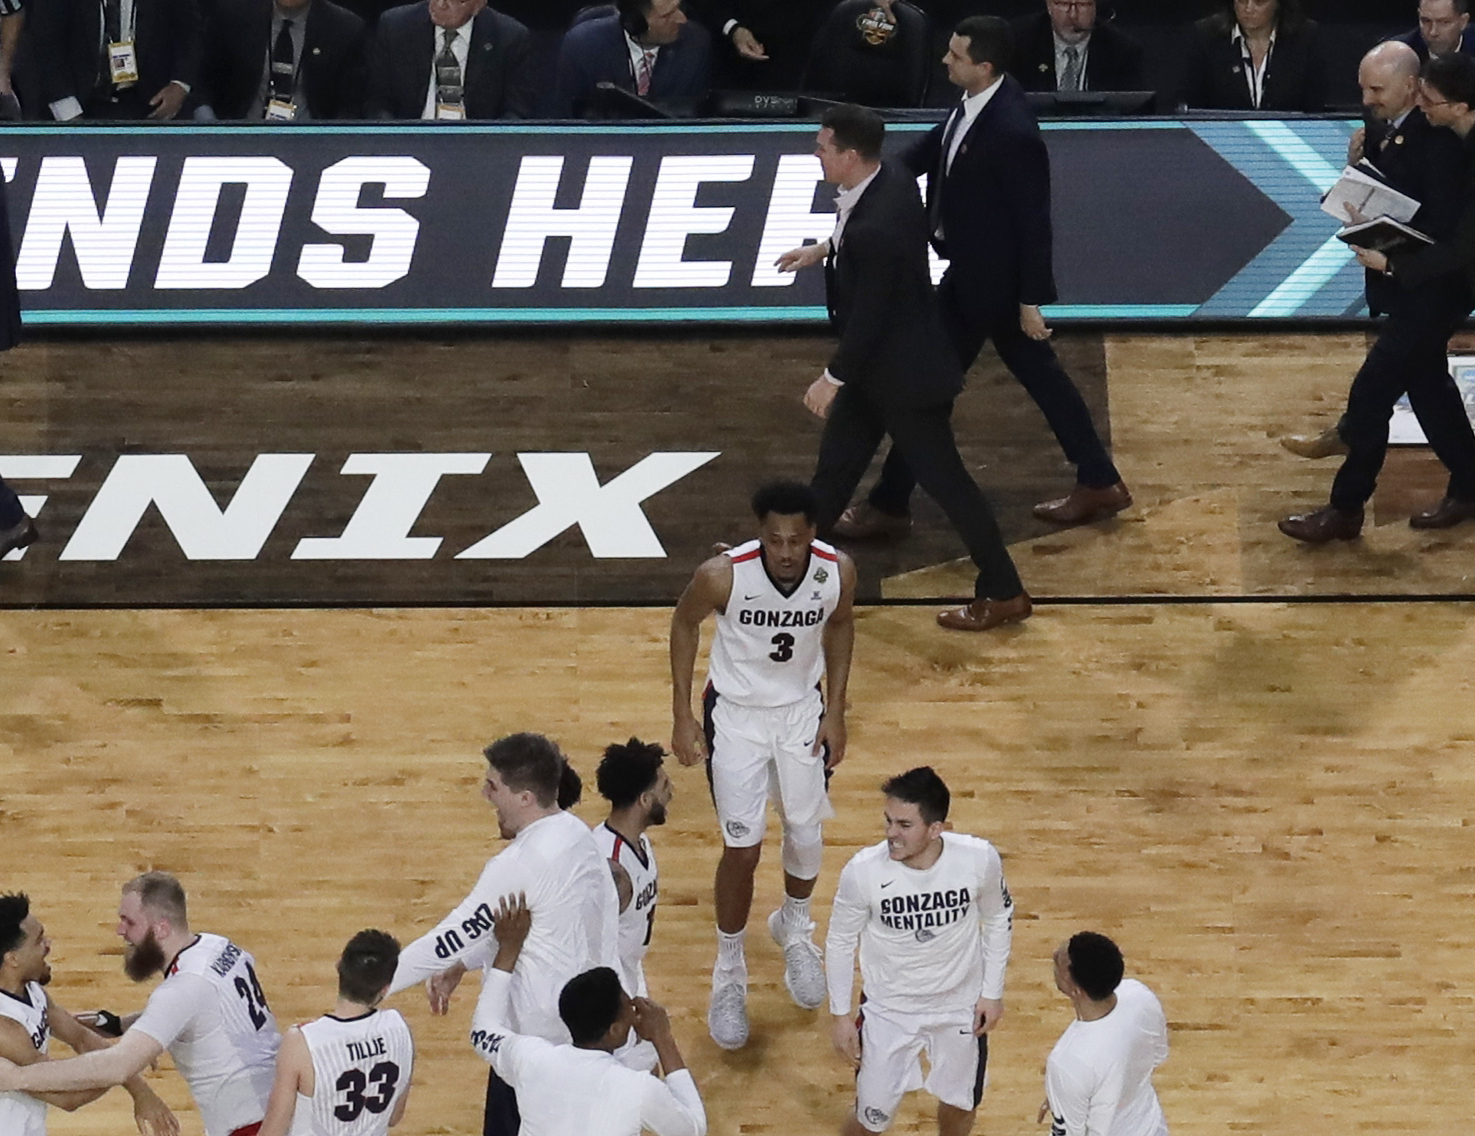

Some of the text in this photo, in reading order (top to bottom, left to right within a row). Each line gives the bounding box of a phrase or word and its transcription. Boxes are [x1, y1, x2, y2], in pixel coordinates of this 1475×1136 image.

[491, 154, 950, 288] HER
[739, 607, 824, 627] GONZAGA
[769, 632, 795, 662] 3
[881, 887, 971, 914] GONZAGA
[880, 904, 970, 931] MENTALITY
[434, 929, 465, 959] UP
[233, 960, 271, 1032] 24
[346, 1037, 387, 1062] TILLIE
[334, 1060, 400, 1122] 33
